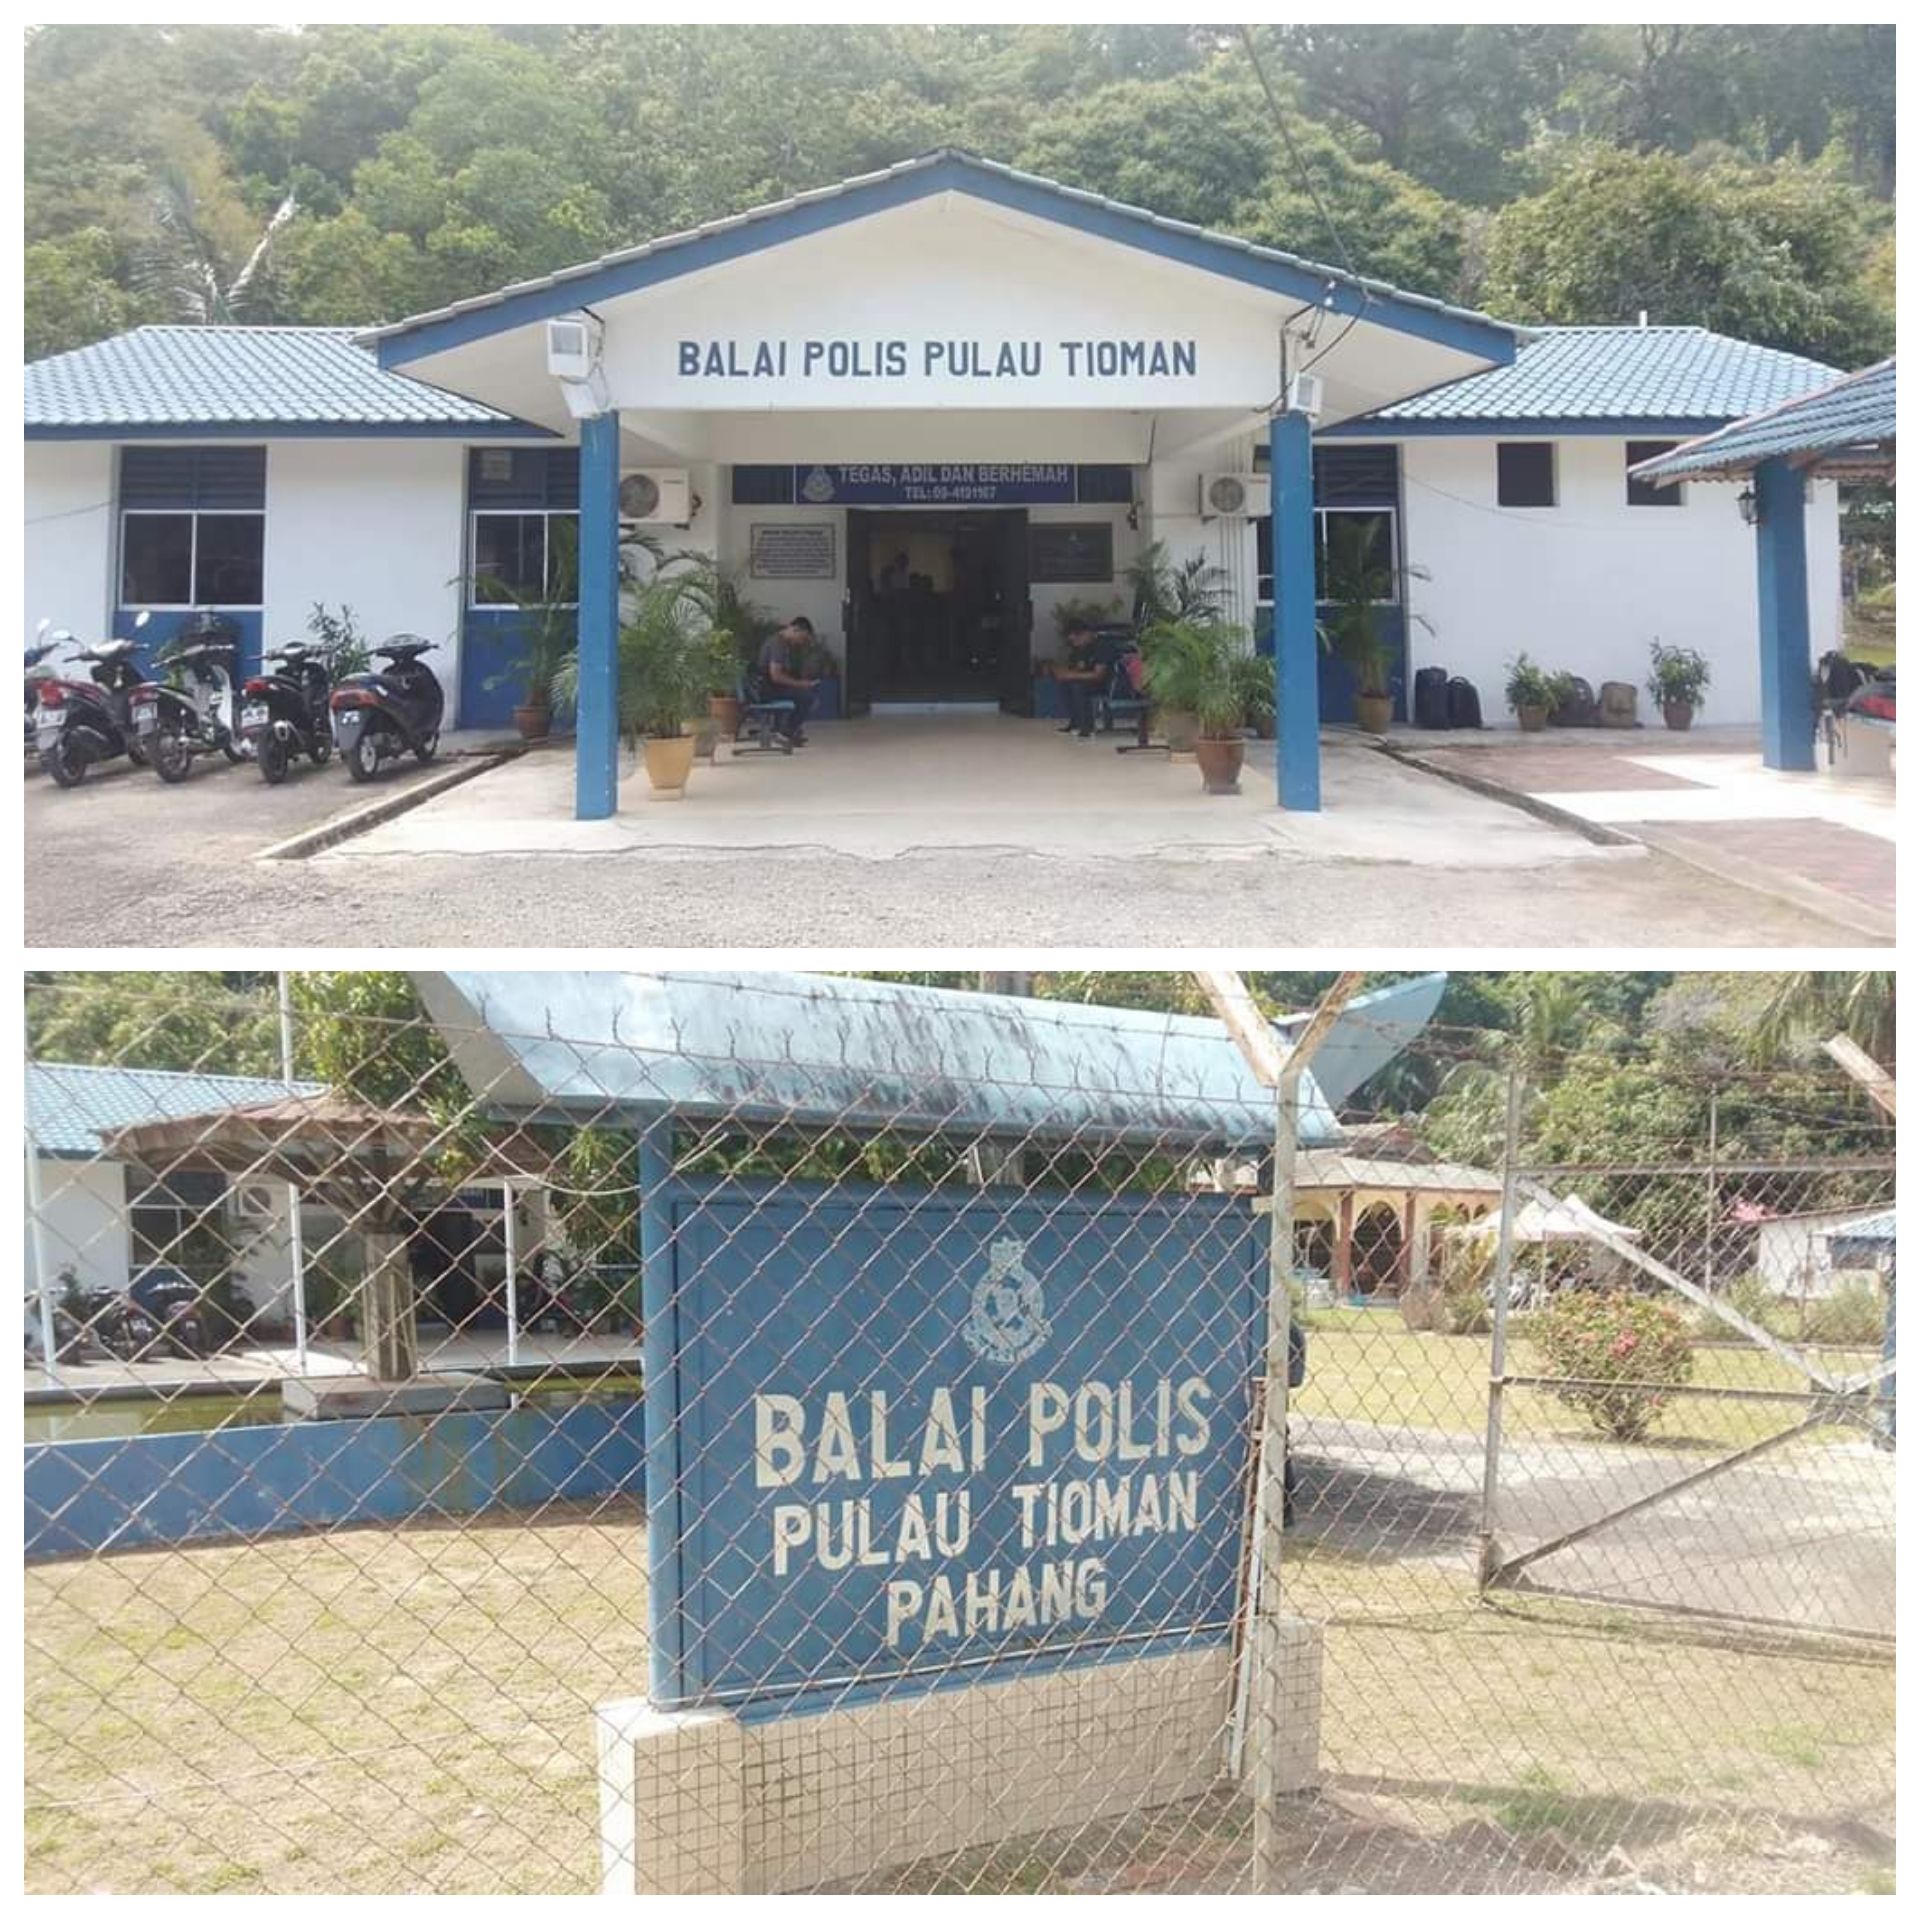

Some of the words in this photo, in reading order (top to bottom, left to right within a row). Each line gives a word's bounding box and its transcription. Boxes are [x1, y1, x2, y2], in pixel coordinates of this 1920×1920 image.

[678, 341, 787, 377] BALAI
[803, 341, 907, 377] POLIS
[924, 341, 1042, 377] PULAU
[1060, 341, 1197, 377] TIOMAN
[839, 465, 897, 487] TEGAS,
[901, 466, 937, 482] ADIL
[941, 466, 975, 482] DAN
[979, 466, 1069, 483] BERHEMAH
[755, 1386, 987, 1487] BALAI
[1028, 1376, 1212, 1467] POLIS
[773, 1491, 971, 1576] PULAU
[1012, 1470, 1199, 1549] TIOMAN
[887, 1558, 1107, 1647] PAHANG
